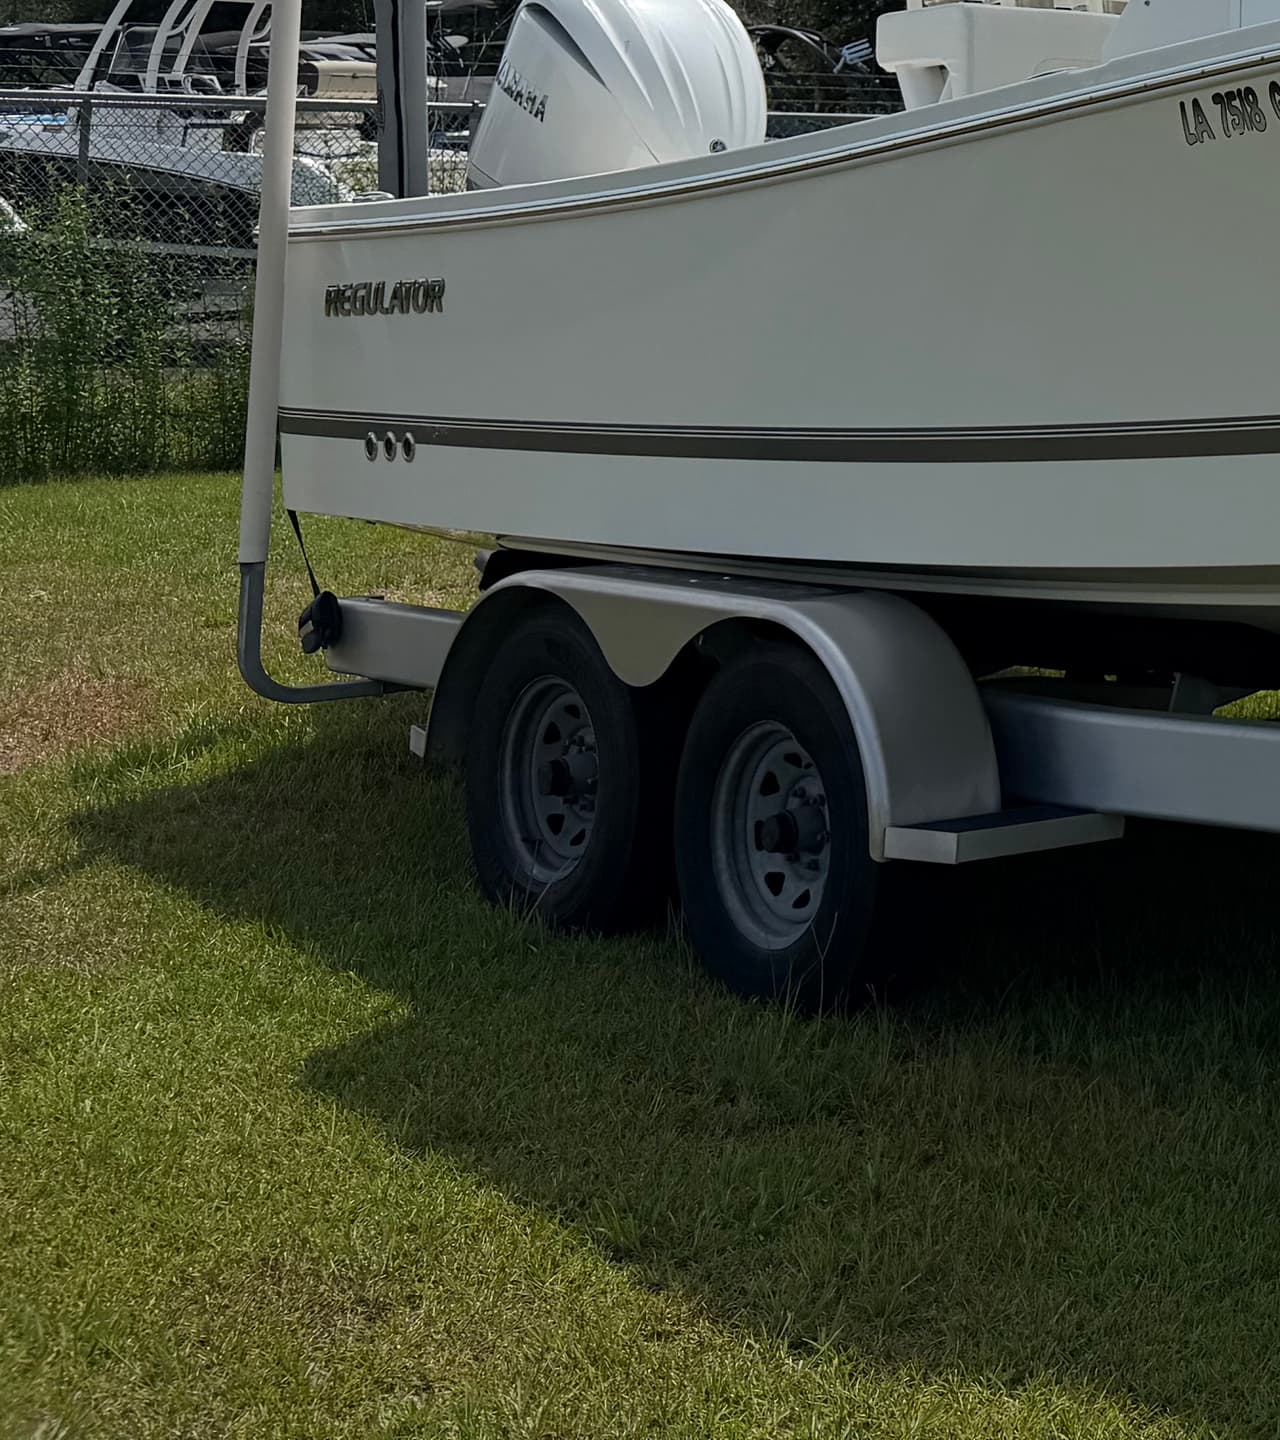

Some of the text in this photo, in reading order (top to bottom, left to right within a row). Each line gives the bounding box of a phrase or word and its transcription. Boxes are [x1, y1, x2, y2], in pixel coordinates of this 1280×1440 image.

[1179, 98, 1217, 146] LA
[1211, 86, 1268, 138] 7518
[324, 278, 445, 318] REGULATOR
